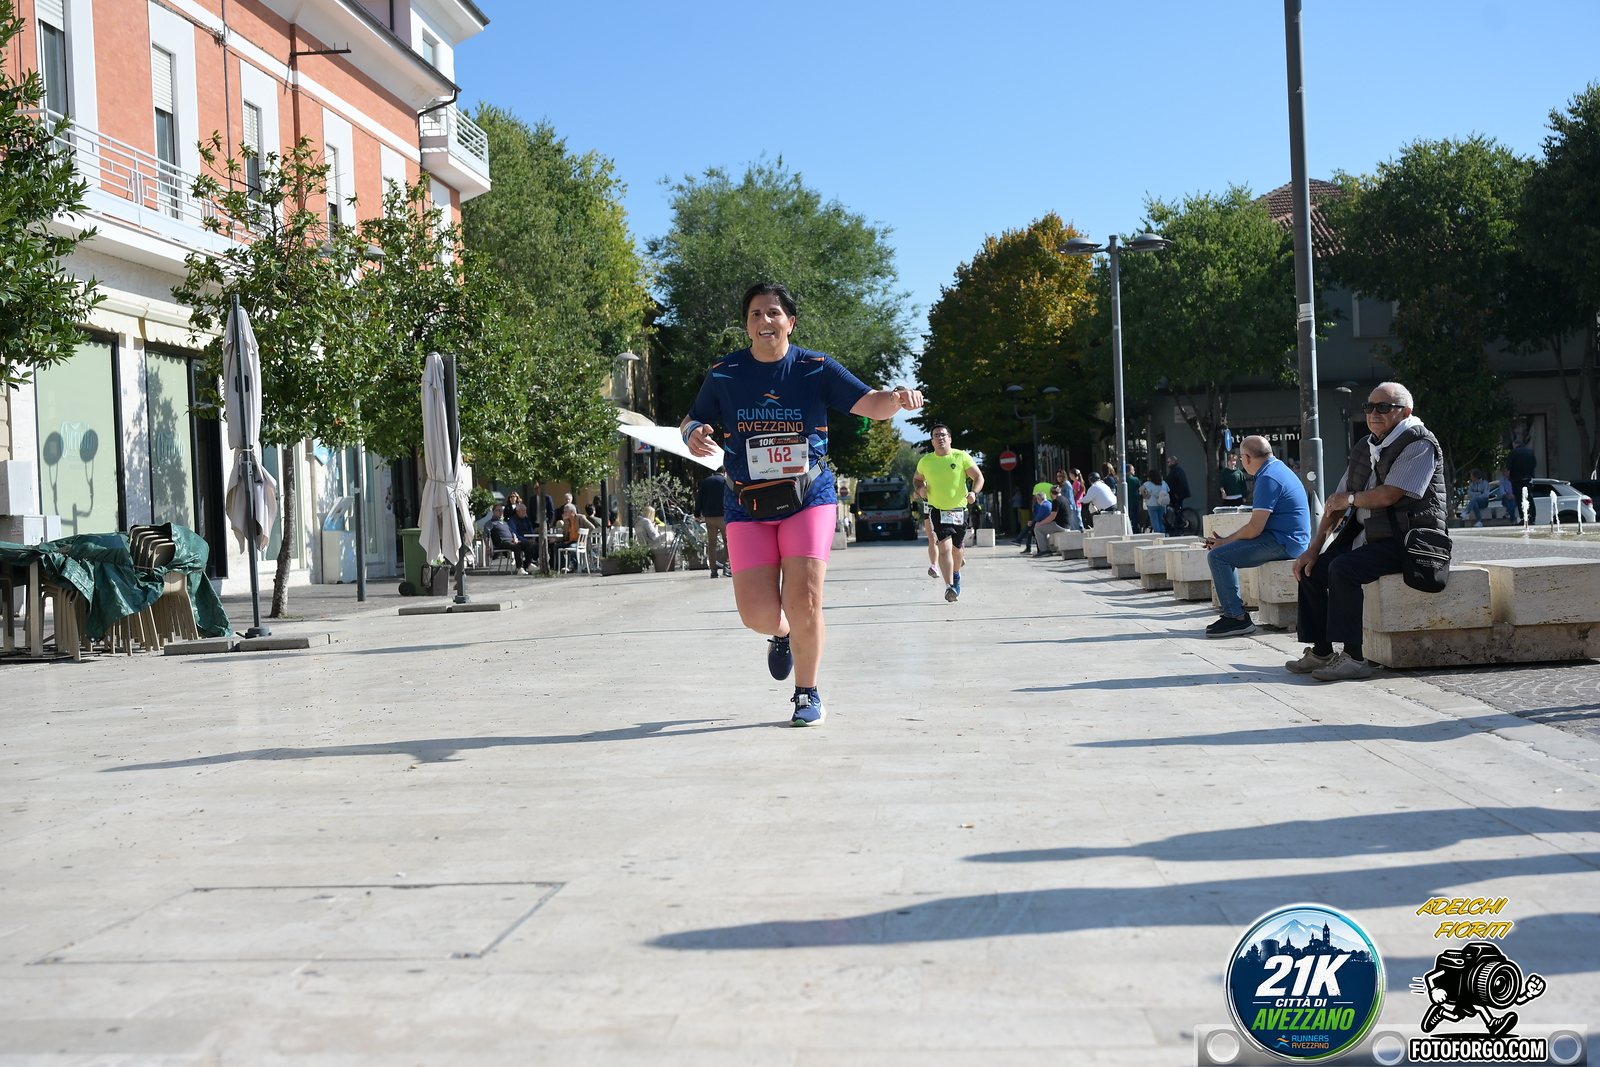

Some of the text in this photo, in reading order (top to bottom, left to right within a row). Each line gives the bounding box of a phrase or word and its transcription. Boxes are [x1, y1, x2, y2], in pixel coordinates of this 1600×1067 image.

[737, 409, 802, 420] RUNNERS
[738, 421, 804, 433] AVEZZANO
[767, 447, 792, 463] 162
